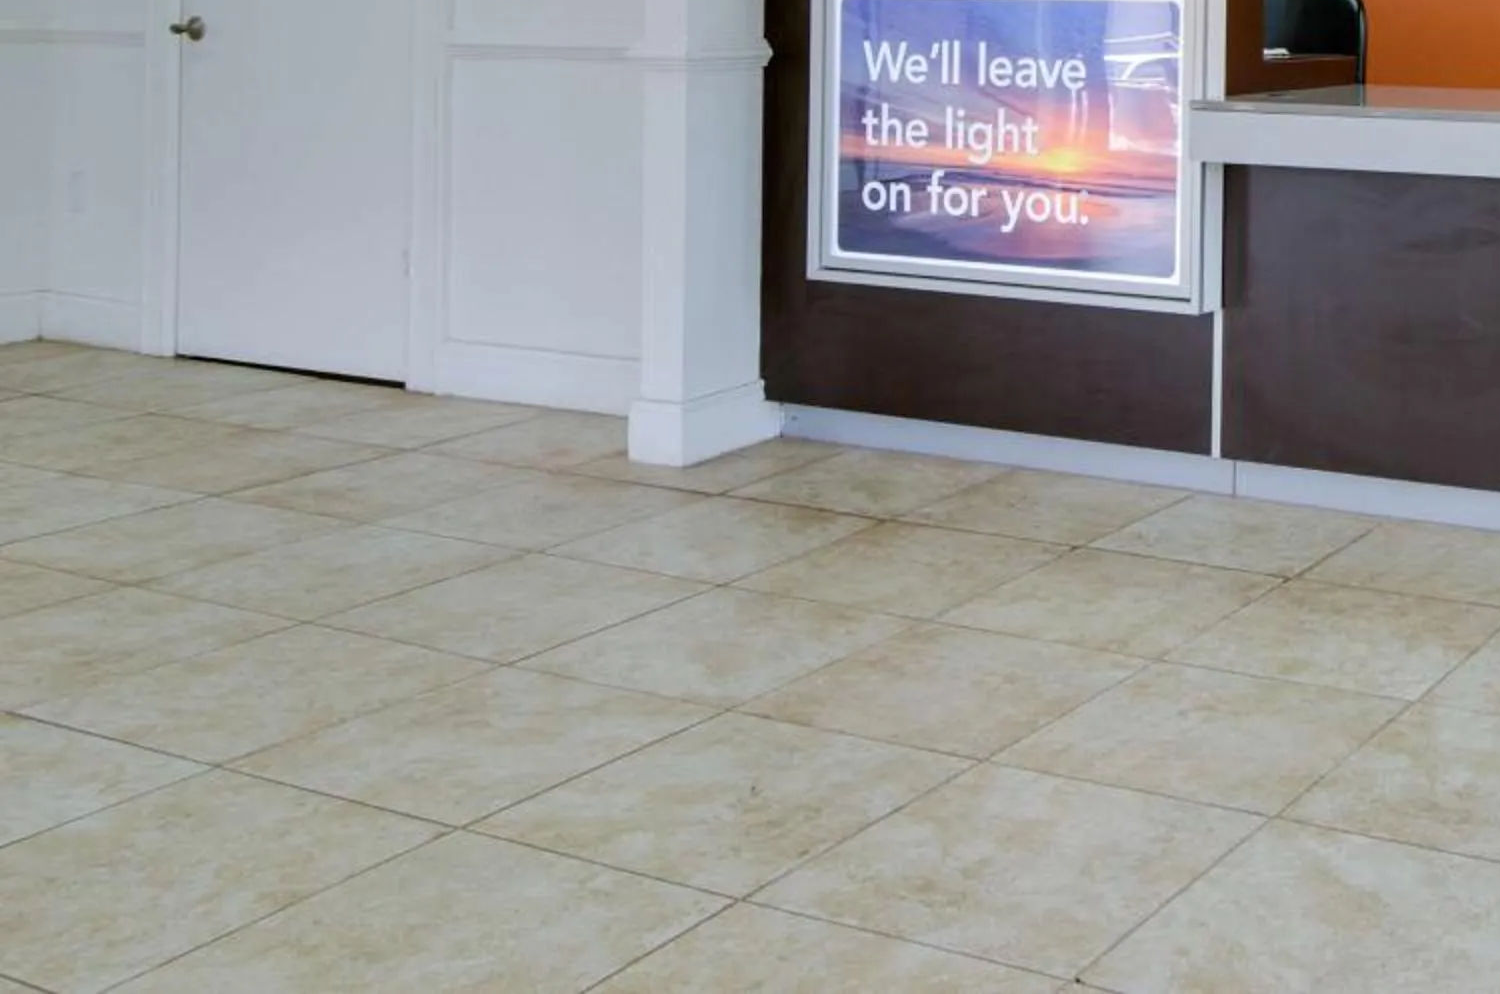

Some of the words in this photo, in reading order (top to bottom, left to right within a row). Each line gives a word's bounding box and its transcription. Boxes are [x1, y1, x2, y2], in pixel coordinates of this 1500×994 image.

[862, 39, 961, 85] We'll
[978, 42, 1087, 89] leave
[862, 103, 929, 148] the
[945, 106, 1038, 165] light
[862, 178, 911, 212] on
[926, 170, 988, 216] for
[1000, 188, 1089, 232] you.
